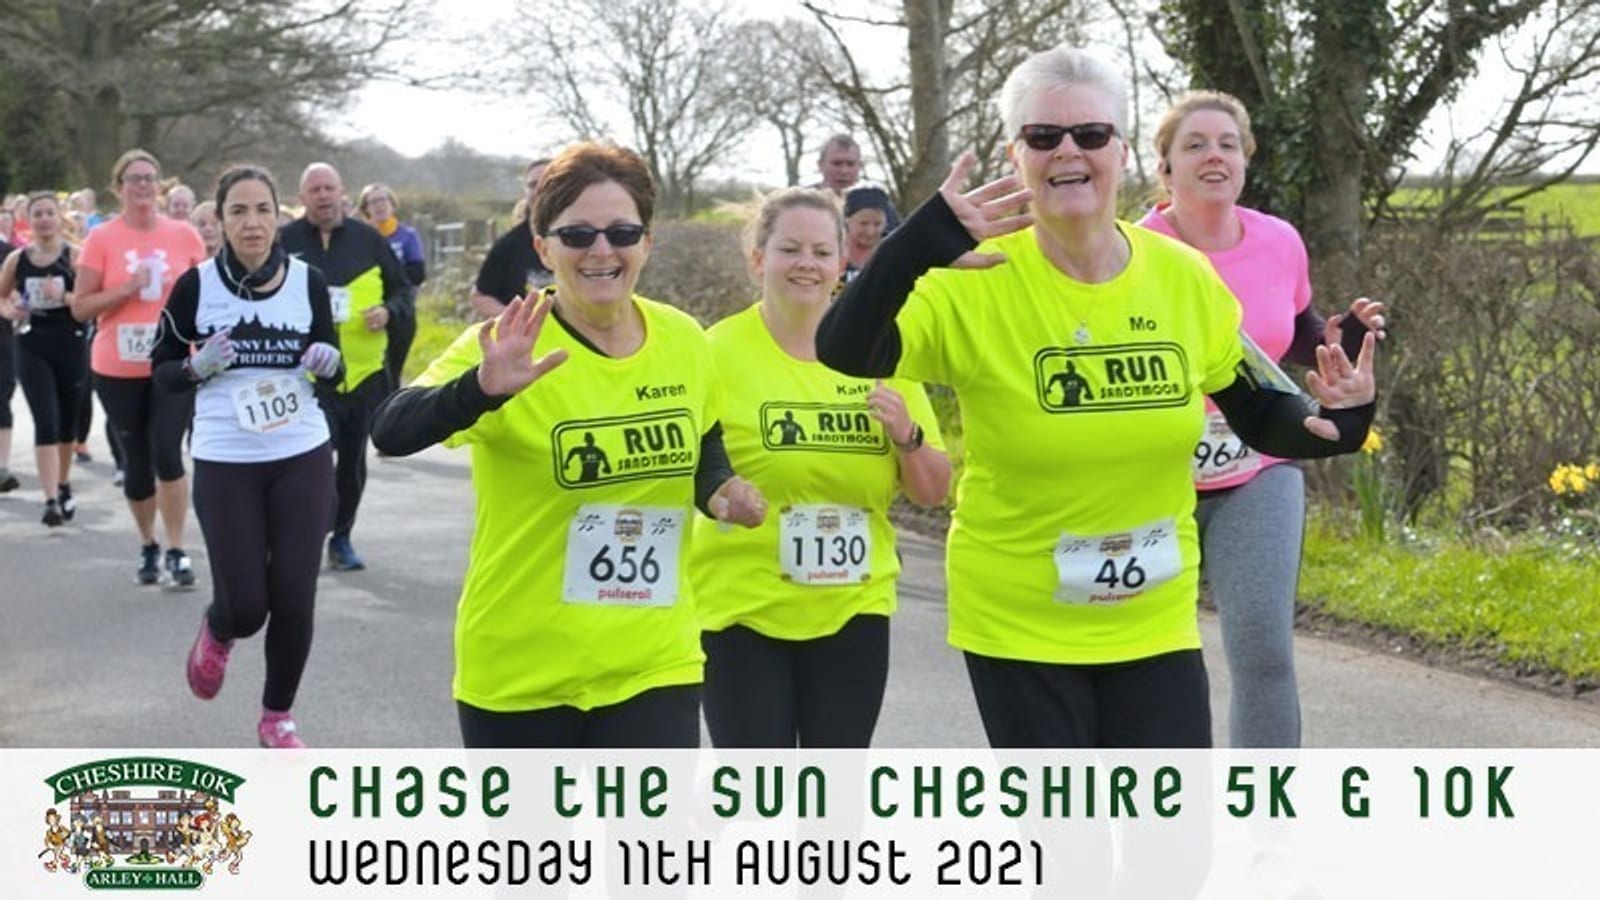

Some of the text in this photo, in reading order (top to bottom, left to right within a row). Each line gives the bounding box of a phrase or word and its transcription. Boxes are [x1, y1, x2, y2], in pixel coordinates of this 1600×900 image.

[1128, 316, 1158, 331] Mo
[1104, 355, 1168, 385] RUN
[245, 391, 299, 425] 1103
[635, 384, 687, 401] Karen
[623, 422, 685, 454] RUN
[818, 412, 872, 433] RUN
[589, 544, 660, 584] 656
[792, 535, 866, 567] 1130
[1094, 556, 1146, 589] 46
